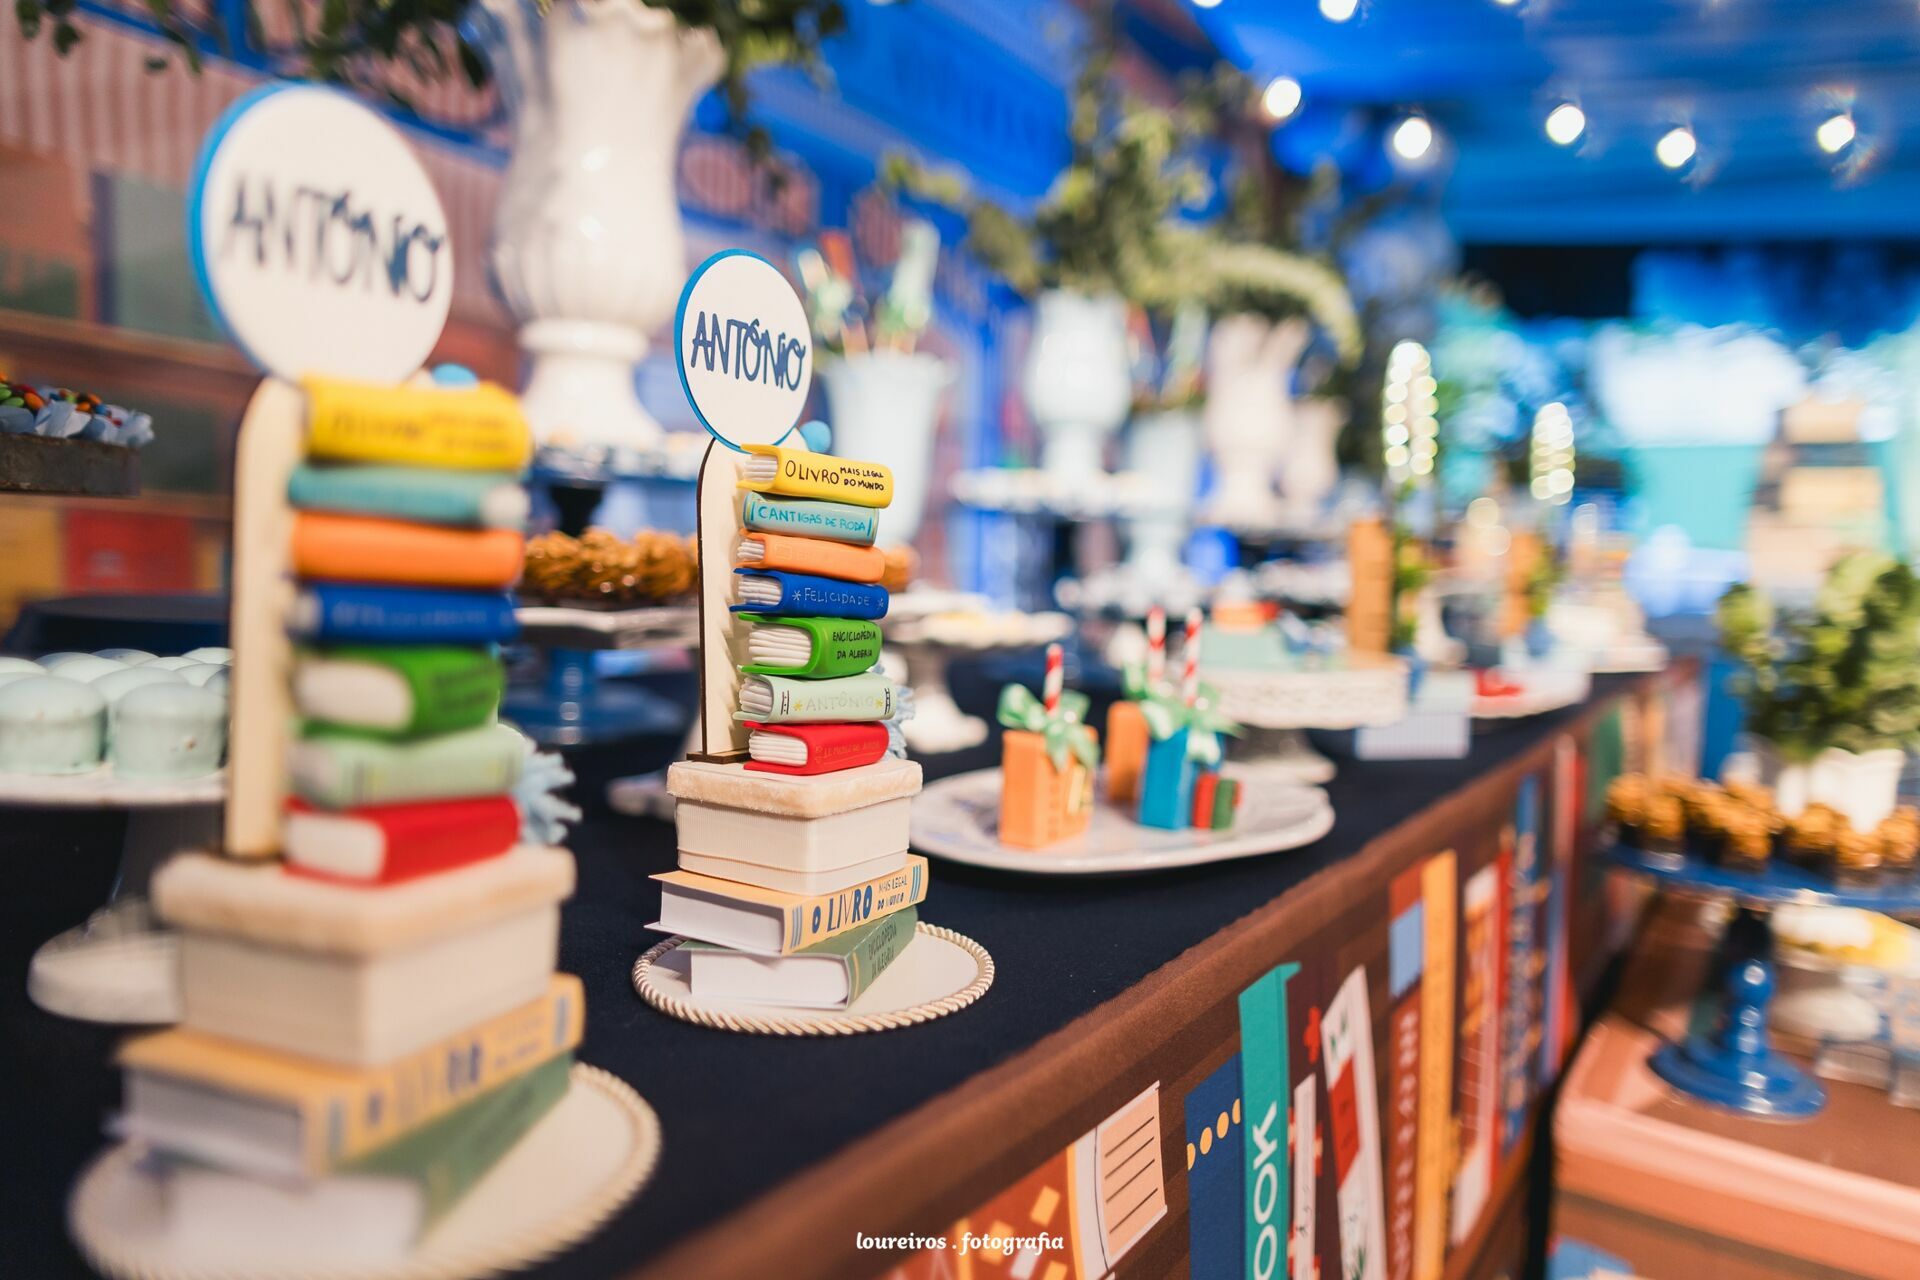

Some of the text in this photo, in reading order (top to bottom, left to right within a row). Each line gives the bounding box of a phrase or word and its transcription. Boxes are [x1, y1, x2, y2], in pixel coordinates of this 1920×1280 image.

[690, 311, 806, 392] ANTÔNIO
[785, 460, 839, 484] O LIVRO
[839, 466, 884, 478] MAIS LEGAL
[843, 478, 884, 490] DO MUNDO
[757, 505, 866, 531] CANTIGAS DE RODA
[803, 586, 871, 606] FELICIDADE
[836, 648, 872, 659] DA ALEGRIA
[805, 691, 874, 711] ANTÔNIO
[891, 874, 907, 888] LEGAL
[812, 884, 872, 933] O LIVRO
